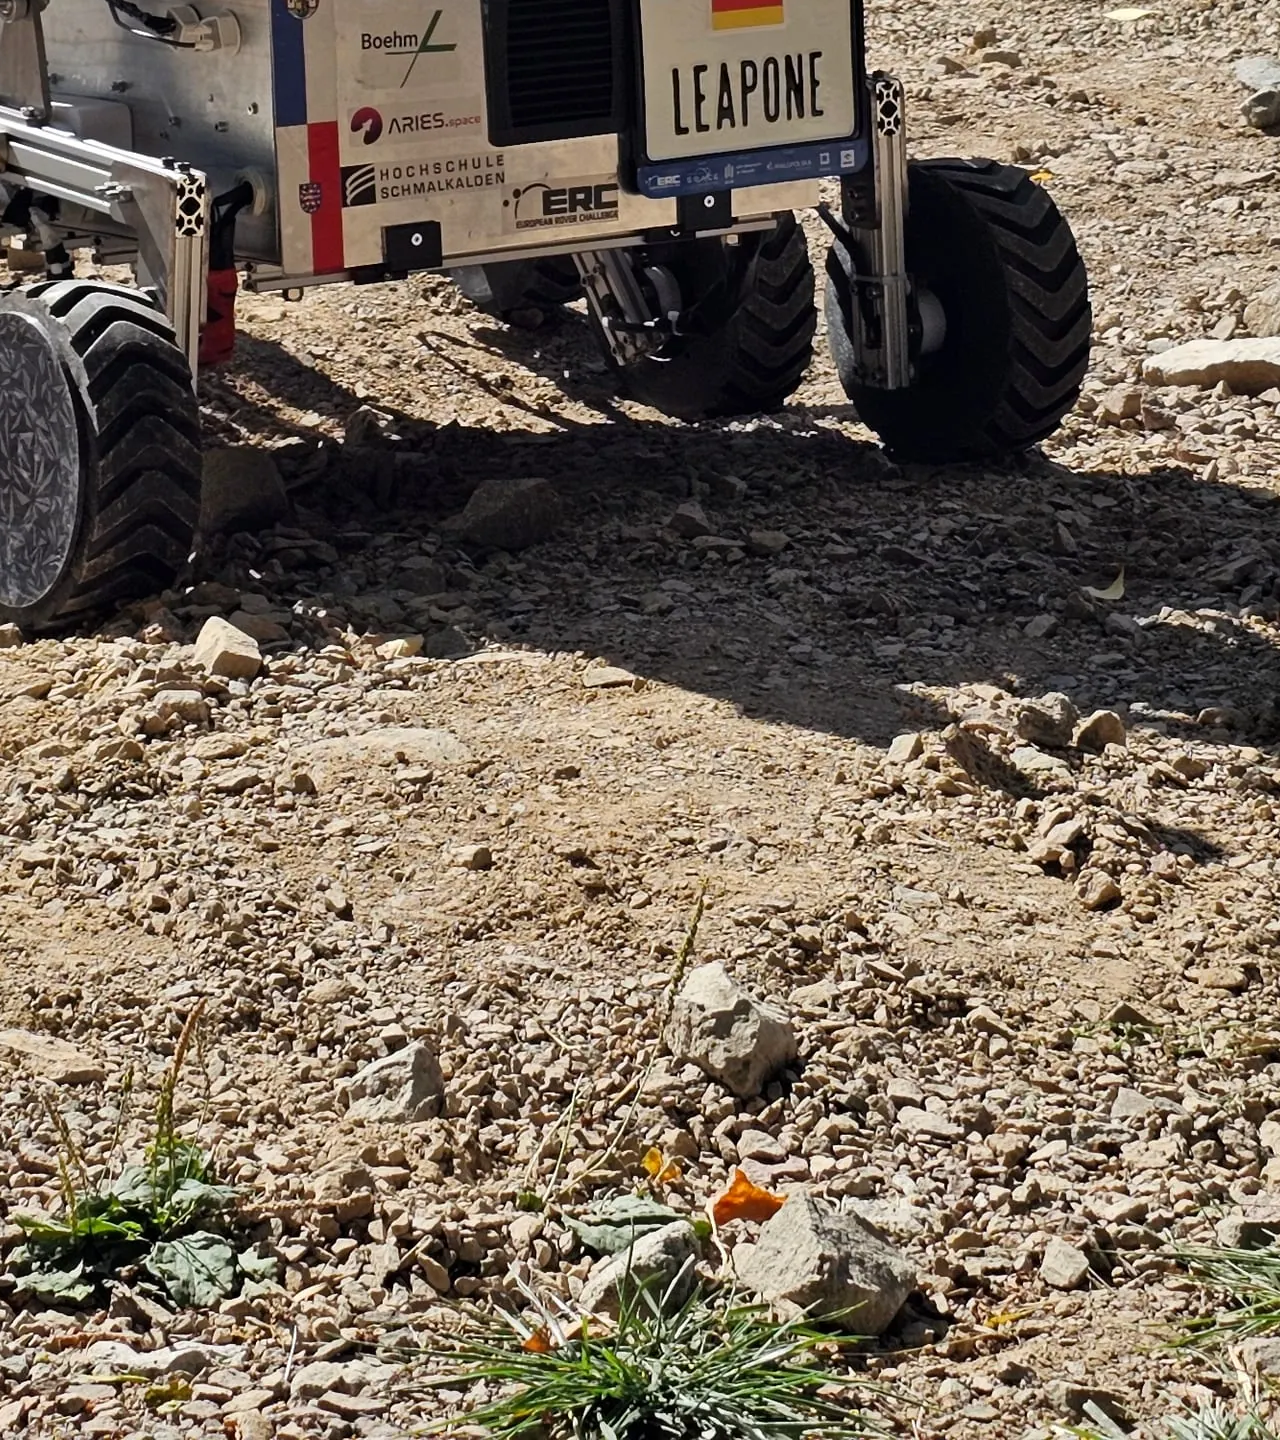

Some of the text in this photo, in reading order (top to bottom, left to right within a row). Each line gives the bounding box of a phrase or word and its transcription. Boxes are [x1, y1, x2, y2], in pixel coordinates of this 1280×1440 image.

[361, 30, 418, 50] Boehm
[671, 50, 825, 136] LEAPONE
[380, 154, 505, 181] HOCHSCHULE
[380, 171, 506, 199] SCHMALKALDEN
[542, 182, 619, 216] ERC
[516, 217, 553, 229] EUROPEAN
[579, 209, 619, 222] CHALLENGE
